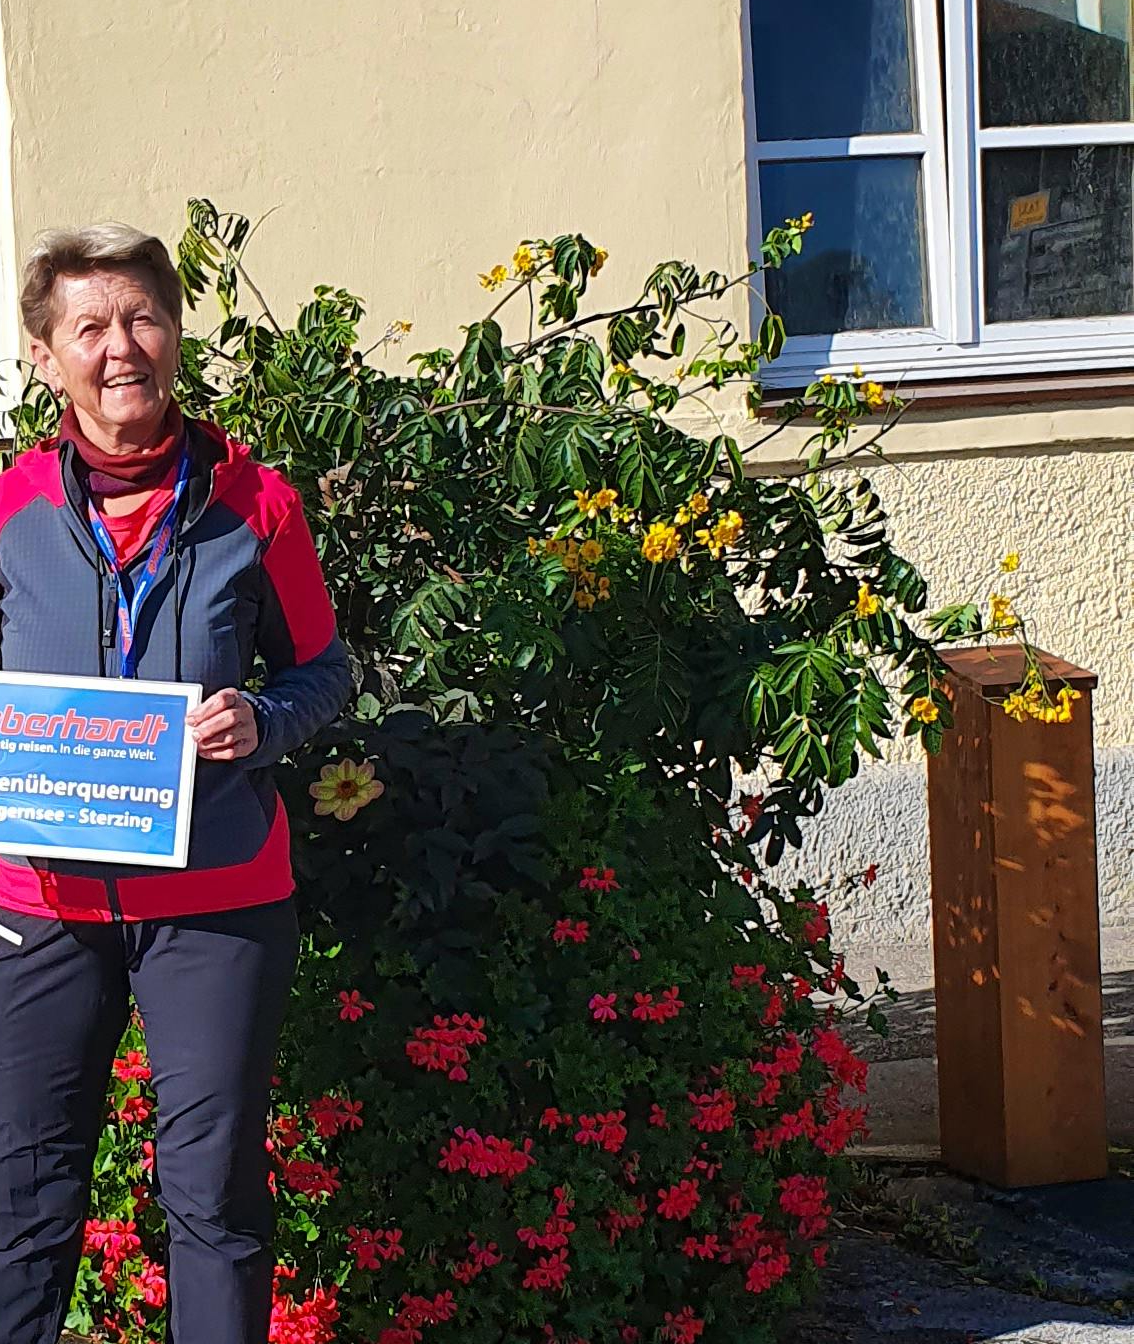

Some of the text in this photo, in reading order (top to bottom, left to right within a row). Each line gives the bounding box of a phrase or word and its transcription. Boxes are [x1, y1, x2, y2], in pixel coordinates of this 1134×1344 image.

[18, 741, 58, 754] reisen.
[60, 743, 70, 754] In
[73, 744, 90, 755] die
[93, 747, 126, 759] ganze
[128, 748, 156, 761] Welt.
[79, 808, 153, 833] Sterzing
